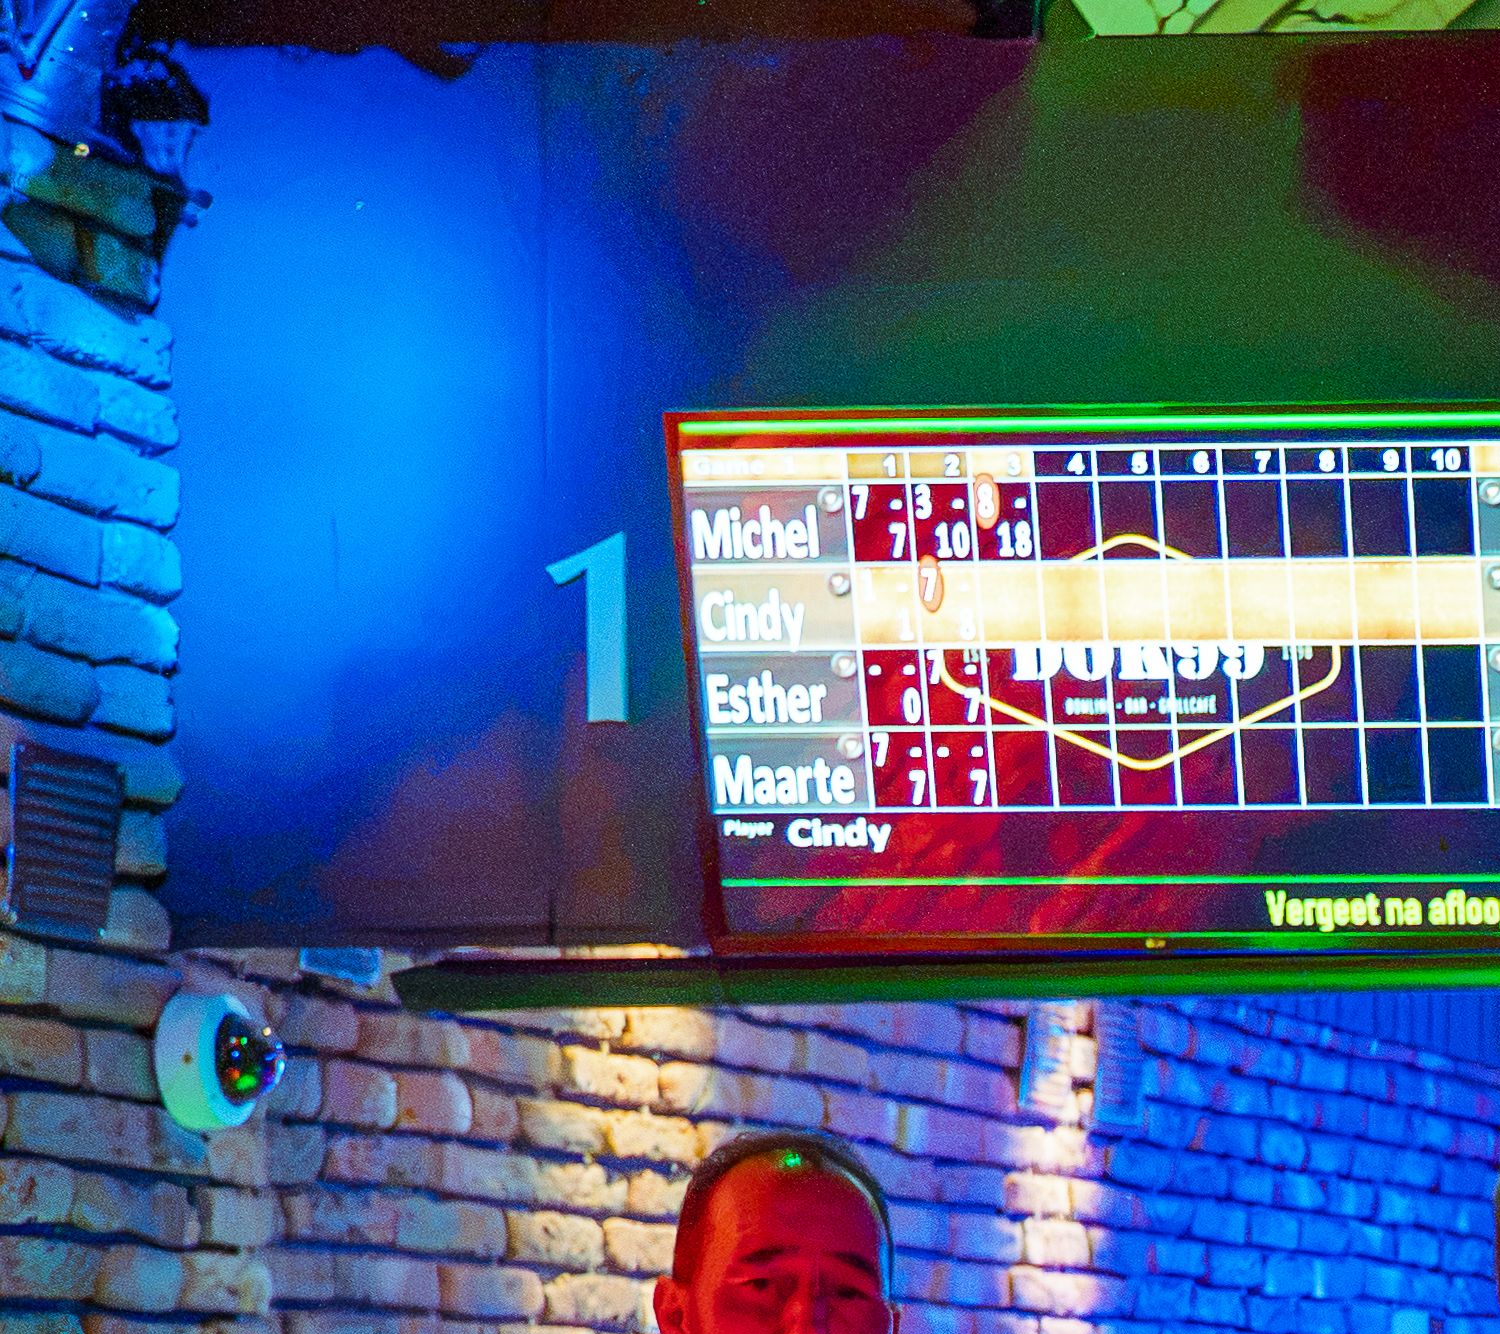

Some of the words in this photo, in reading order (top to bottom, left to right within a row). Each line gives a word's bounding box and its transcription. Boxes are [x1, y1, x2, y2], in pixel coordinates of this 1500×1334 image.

[883, 454, 897, 477] 1
[944, 455, 961, 476] 2
[1007, 454, 1021, 476] 3
[1067, 452, 1085, 475] 4
[1132, 453, 1149, 474] 5
[1193, 451, 1210, 473] 6
[1255, 451, 1271, 473] 7
[1319, 450, 1335, 472] 8
[1384, 450, 1400, 472] 9
[1430, 450, 1461, 471] 10
[851, 485, 869, 520] 7
[914, 484, 932, 520] 3
[977, 484, 995, 518] 8
[690, 504, 820, 560] Michel
[889, 522, 907, 558] 7
[935, 522, 970, 558] 10
[997, 521, 1032, 557] 18
[920, 567, 938, 602] 7
[545, 531, 628, 722] 1
[700, 588, 805, 651] Cindy
[706, 670, 827, 723] Esther
[903, 687, 921, 723] 0
[964, 687, 981, 723] 7
[872, 732, 889, 767] 7
[713, 755, 856, 806] Maarte
[909, 769, 926, 805] 7
[970, 769, 988, 805] 7
[723, 820, 774, 838] Player
[787, 817, 892, 853] Cindy
[1264, 890, 1381, 932] Vergeet
[1384, 897, 1423, 926] na
